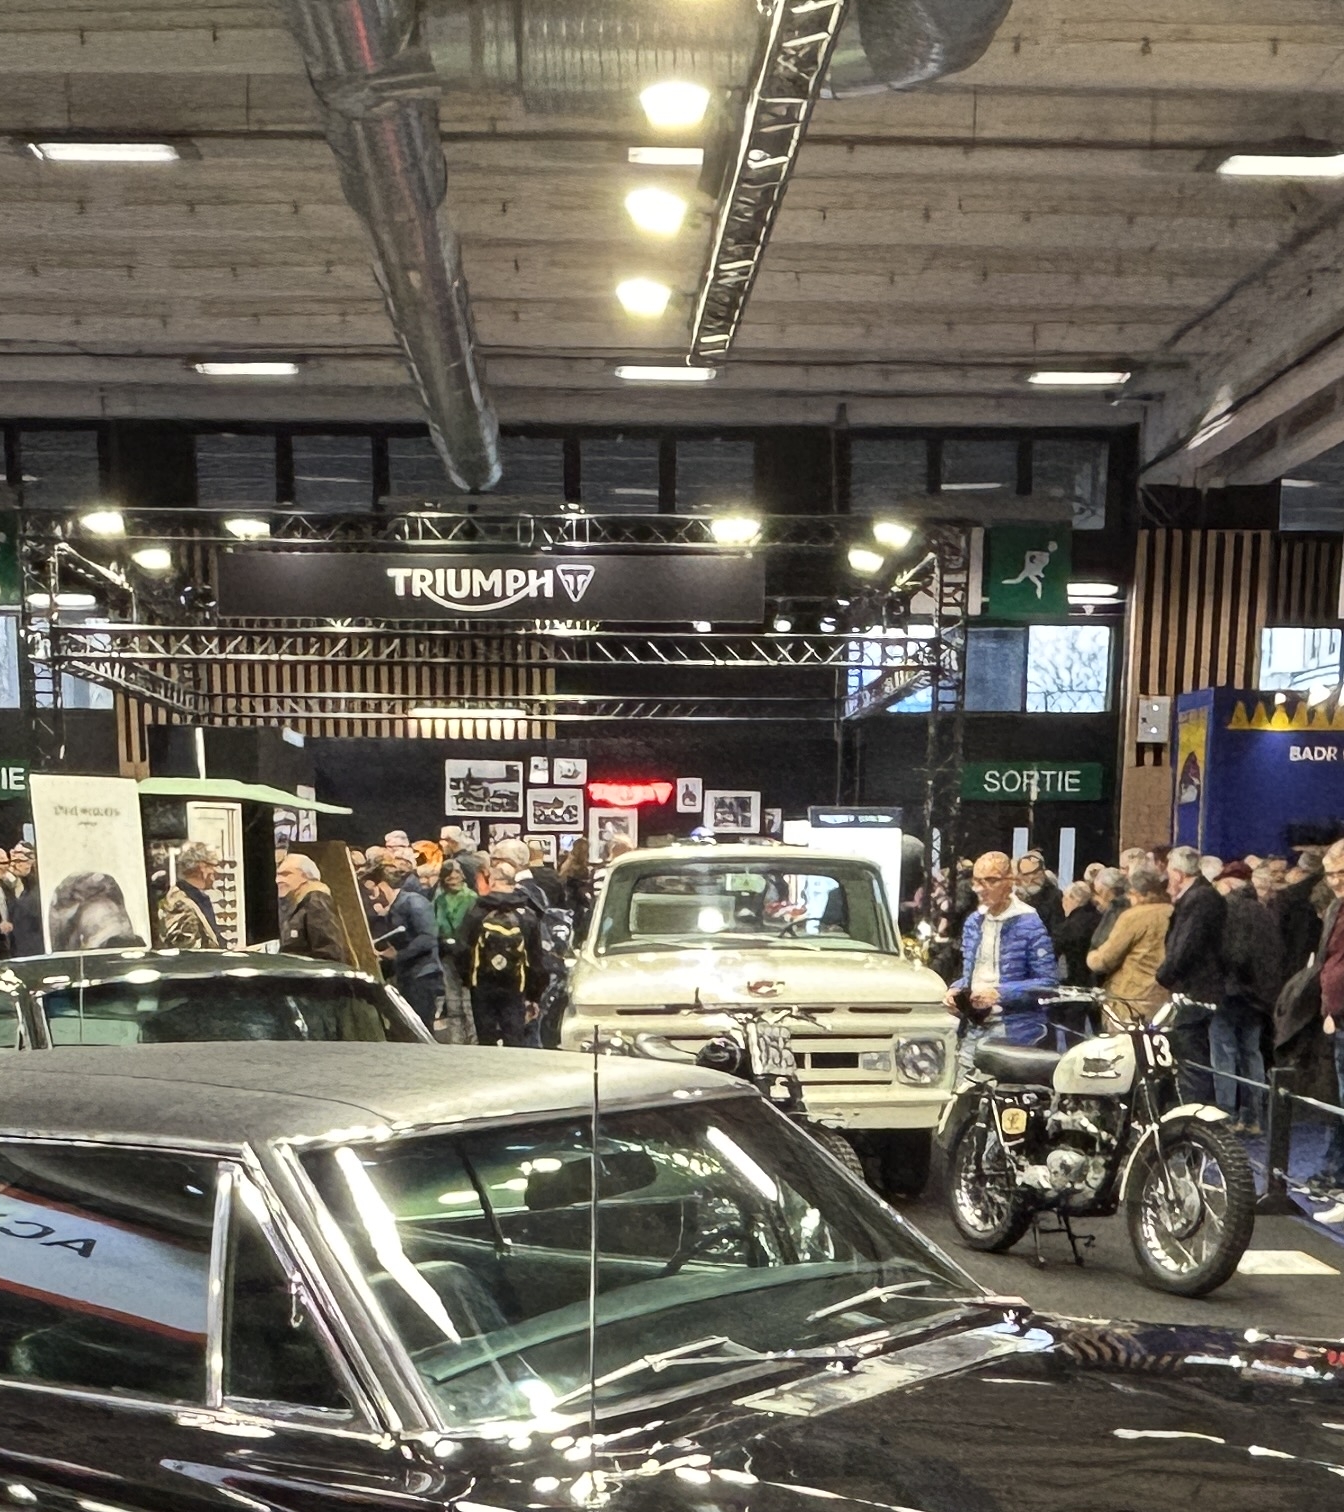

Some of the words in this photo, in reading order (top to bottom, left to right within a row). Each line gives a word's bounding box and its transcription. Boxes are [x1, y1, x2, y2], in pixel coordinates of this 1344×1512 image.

[386, 567, 554, 612] TRIUMPH
[1289, 746, 1338, 761] BADR
[983, 770, 1082, 792] SORTIE
[1142, 1033, 1173, 1067] 13
